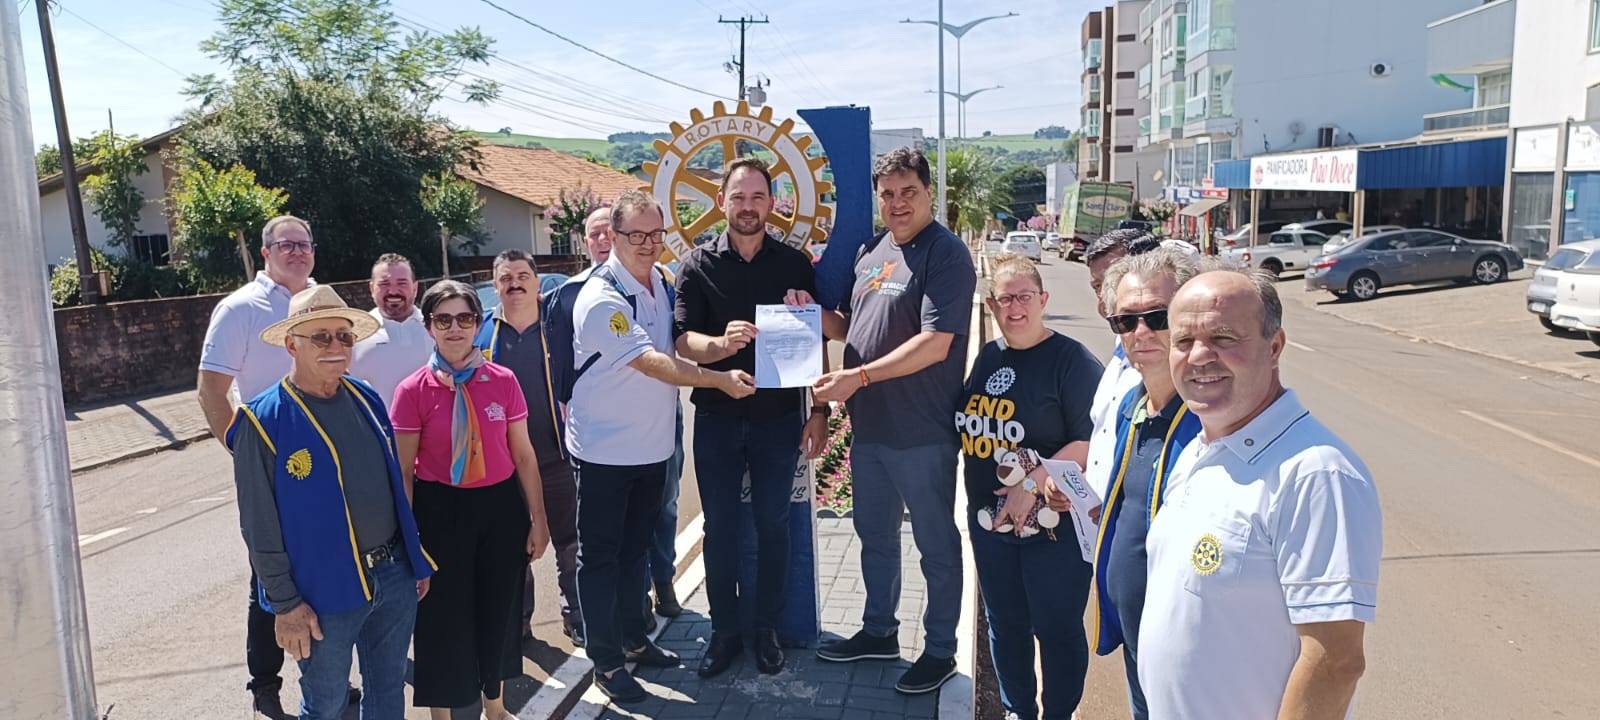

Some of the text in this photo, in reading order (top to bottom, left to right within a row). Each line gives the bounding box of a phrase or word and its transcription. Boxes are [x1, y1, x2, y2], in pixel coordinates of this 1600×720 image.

[684, 118, 767, 147] ROTARY
[1266, 155, 1354, 184] PANIFICADORA Pão Doce
[964, 394, 1016, 422] END
[954, 411, 1025, 444] POLIO
